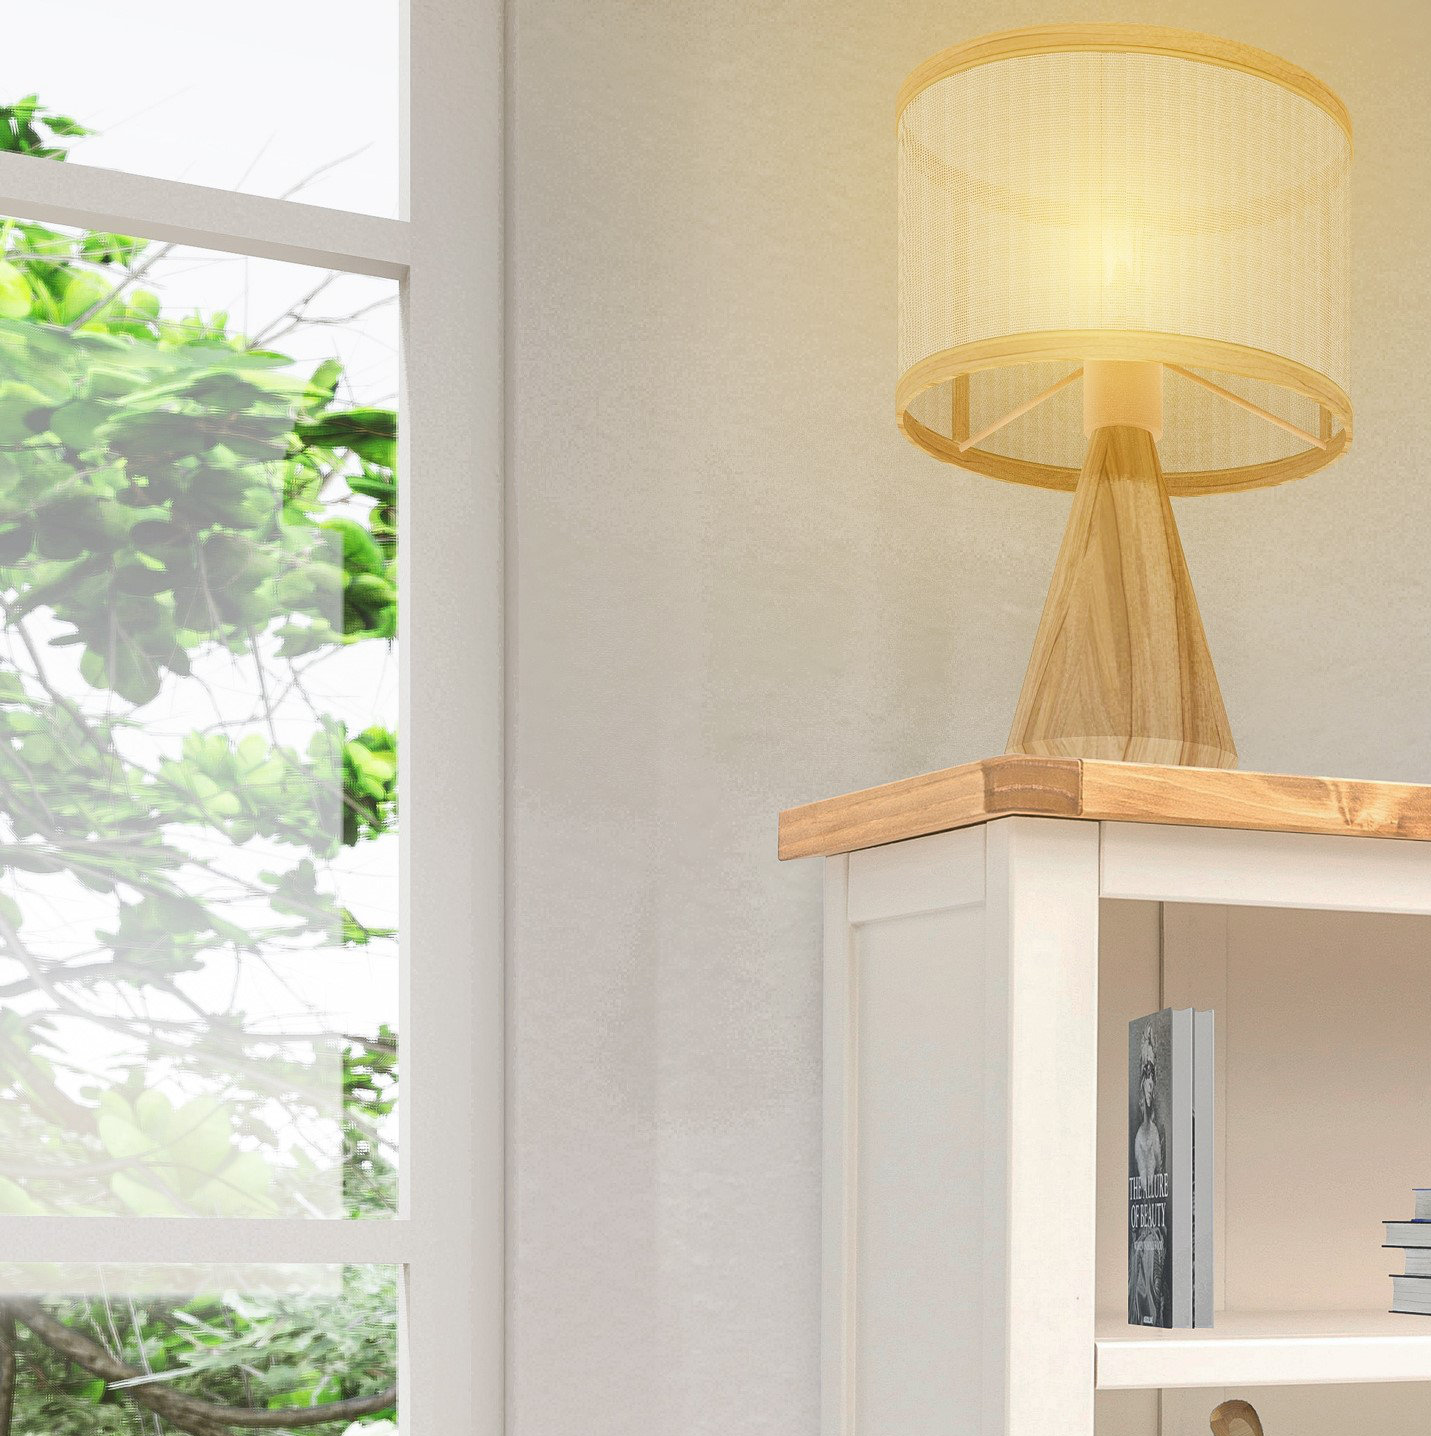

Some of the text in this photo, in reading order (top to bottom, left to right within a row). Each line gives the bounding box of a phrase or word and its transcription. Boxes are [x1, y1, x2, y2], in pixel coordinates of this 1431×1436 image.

[1129, 1176, 1142, 1200] THE
[1131, 1203, 1166, 1228] OF BEAUTY
